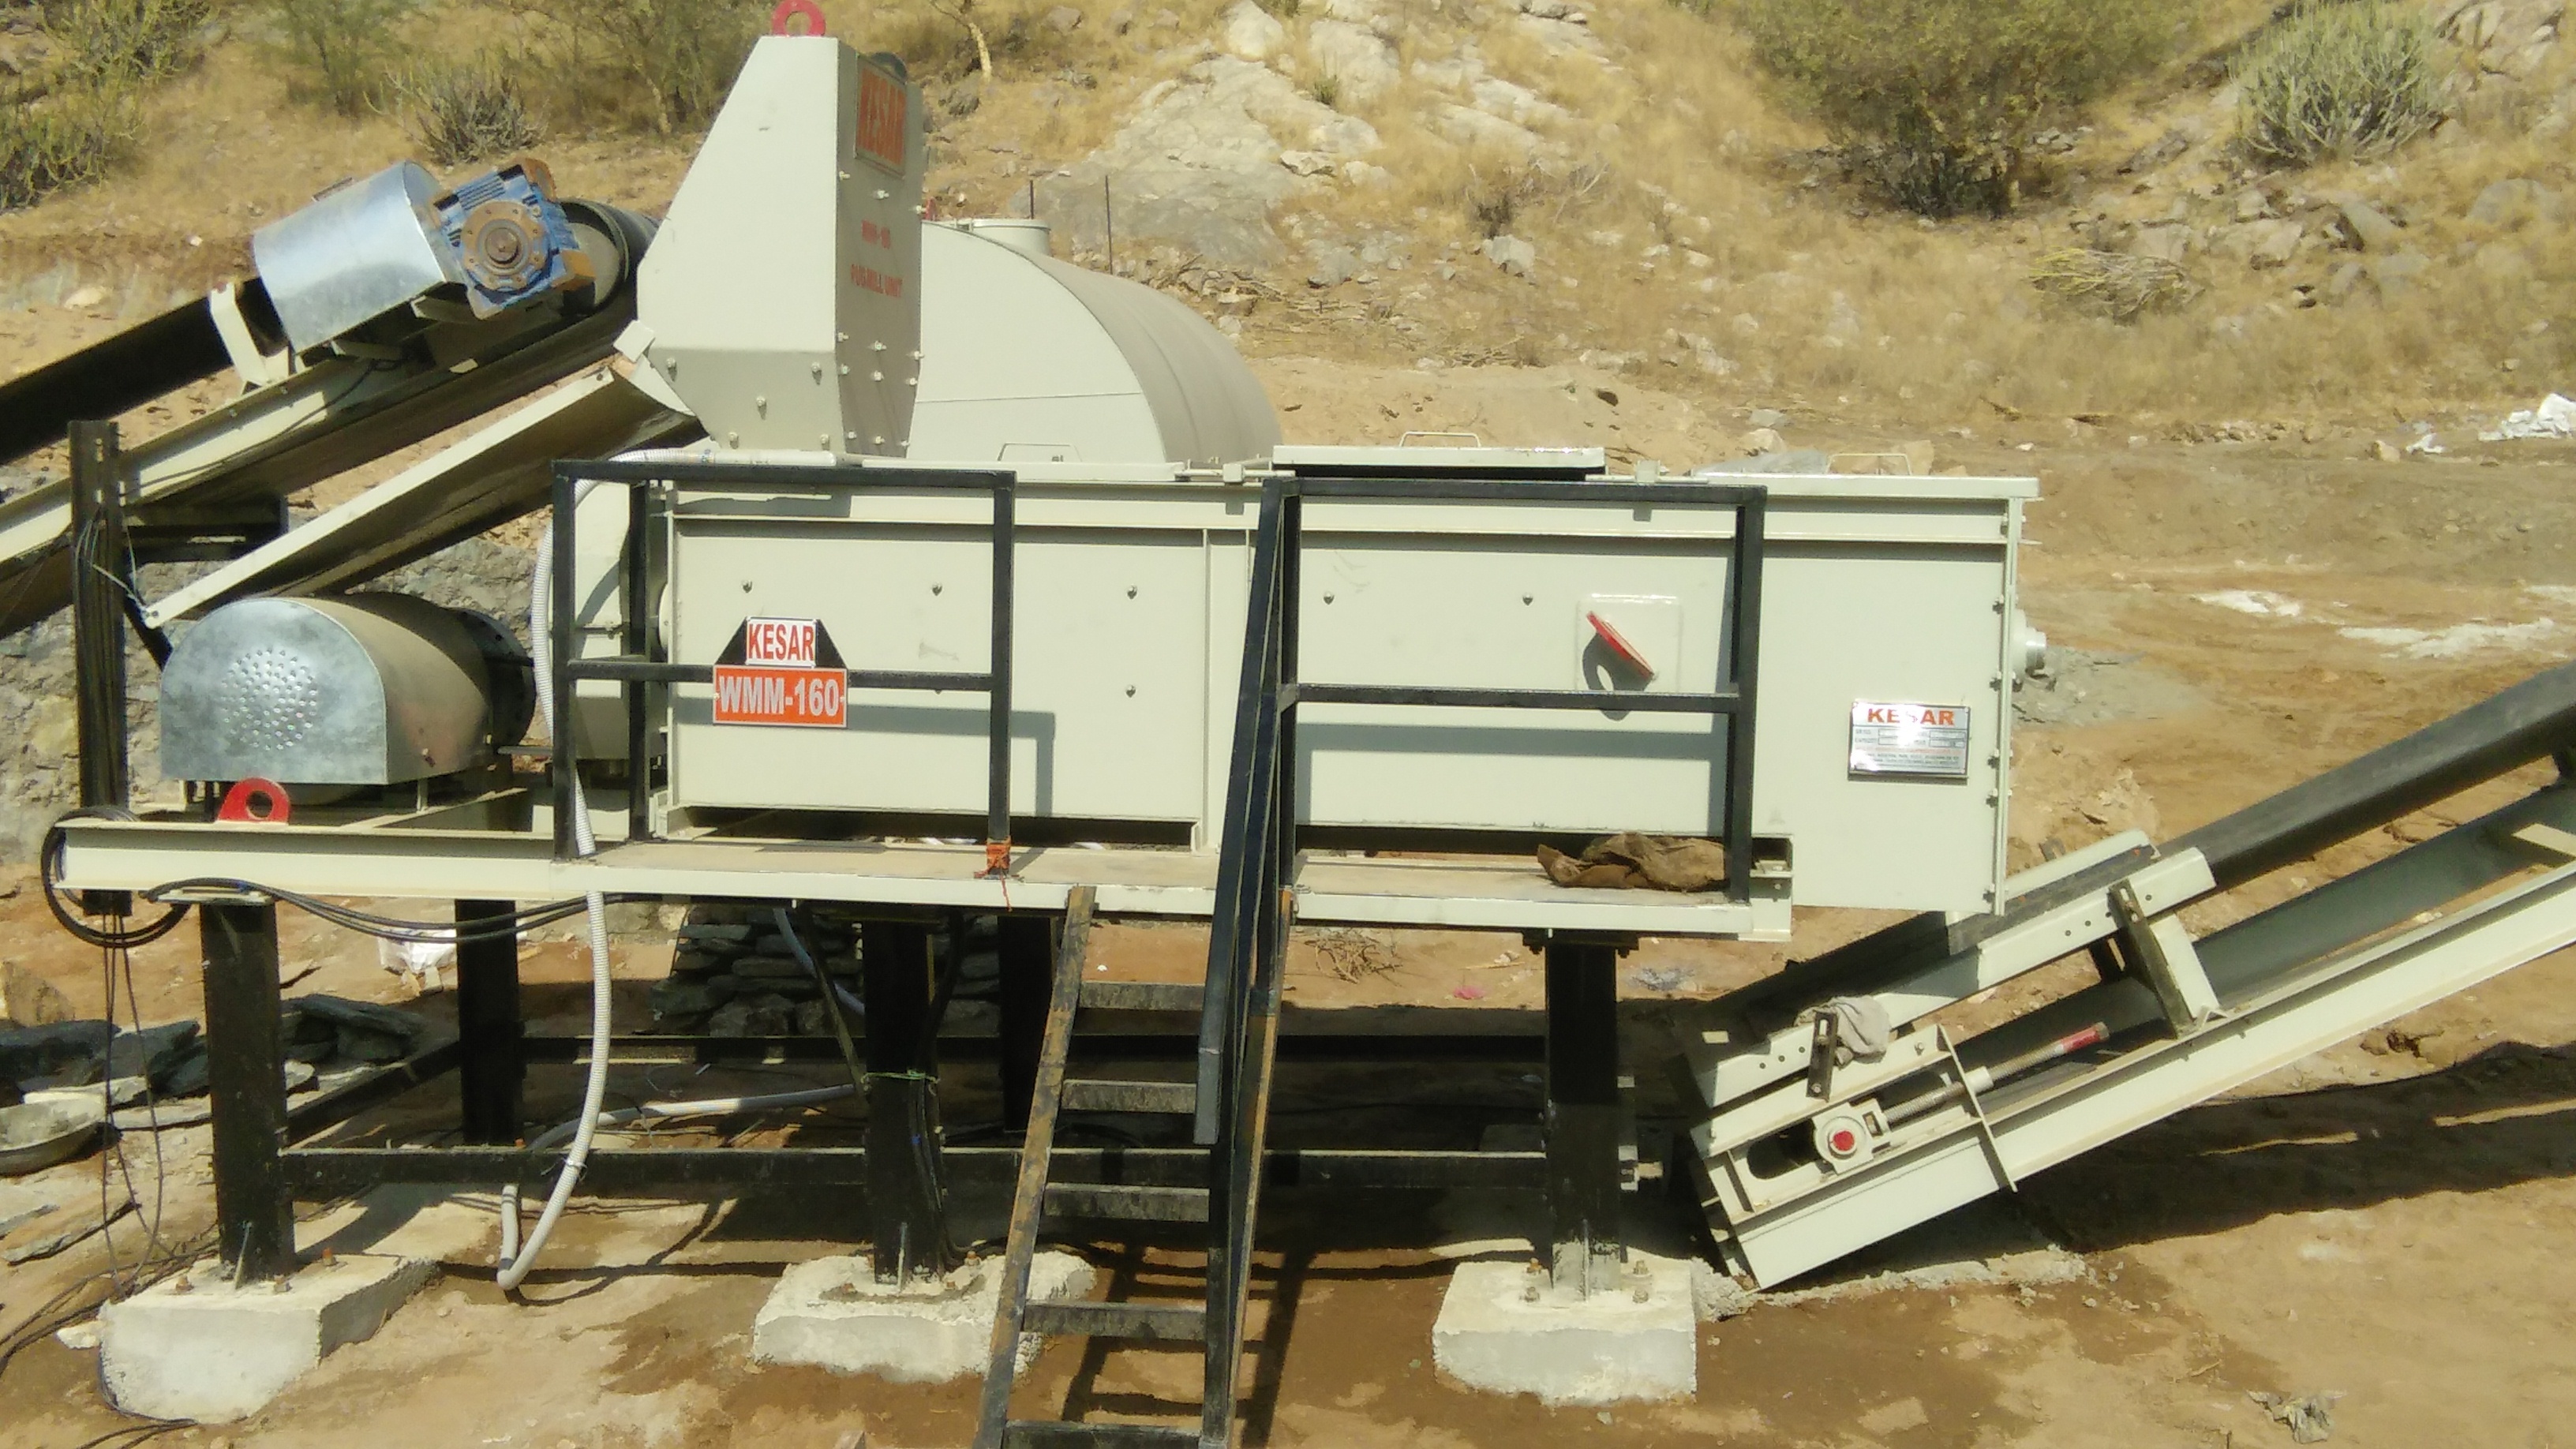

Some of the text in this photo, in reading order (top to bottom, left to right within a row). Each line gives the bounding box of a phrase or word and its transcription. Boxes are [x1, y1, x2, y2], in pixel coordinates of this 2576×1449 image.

[885, 275, 902, 298] UNIT
[749, 623, 814, 661] KESAR
[719, 676, 839, 717] WMM-160
